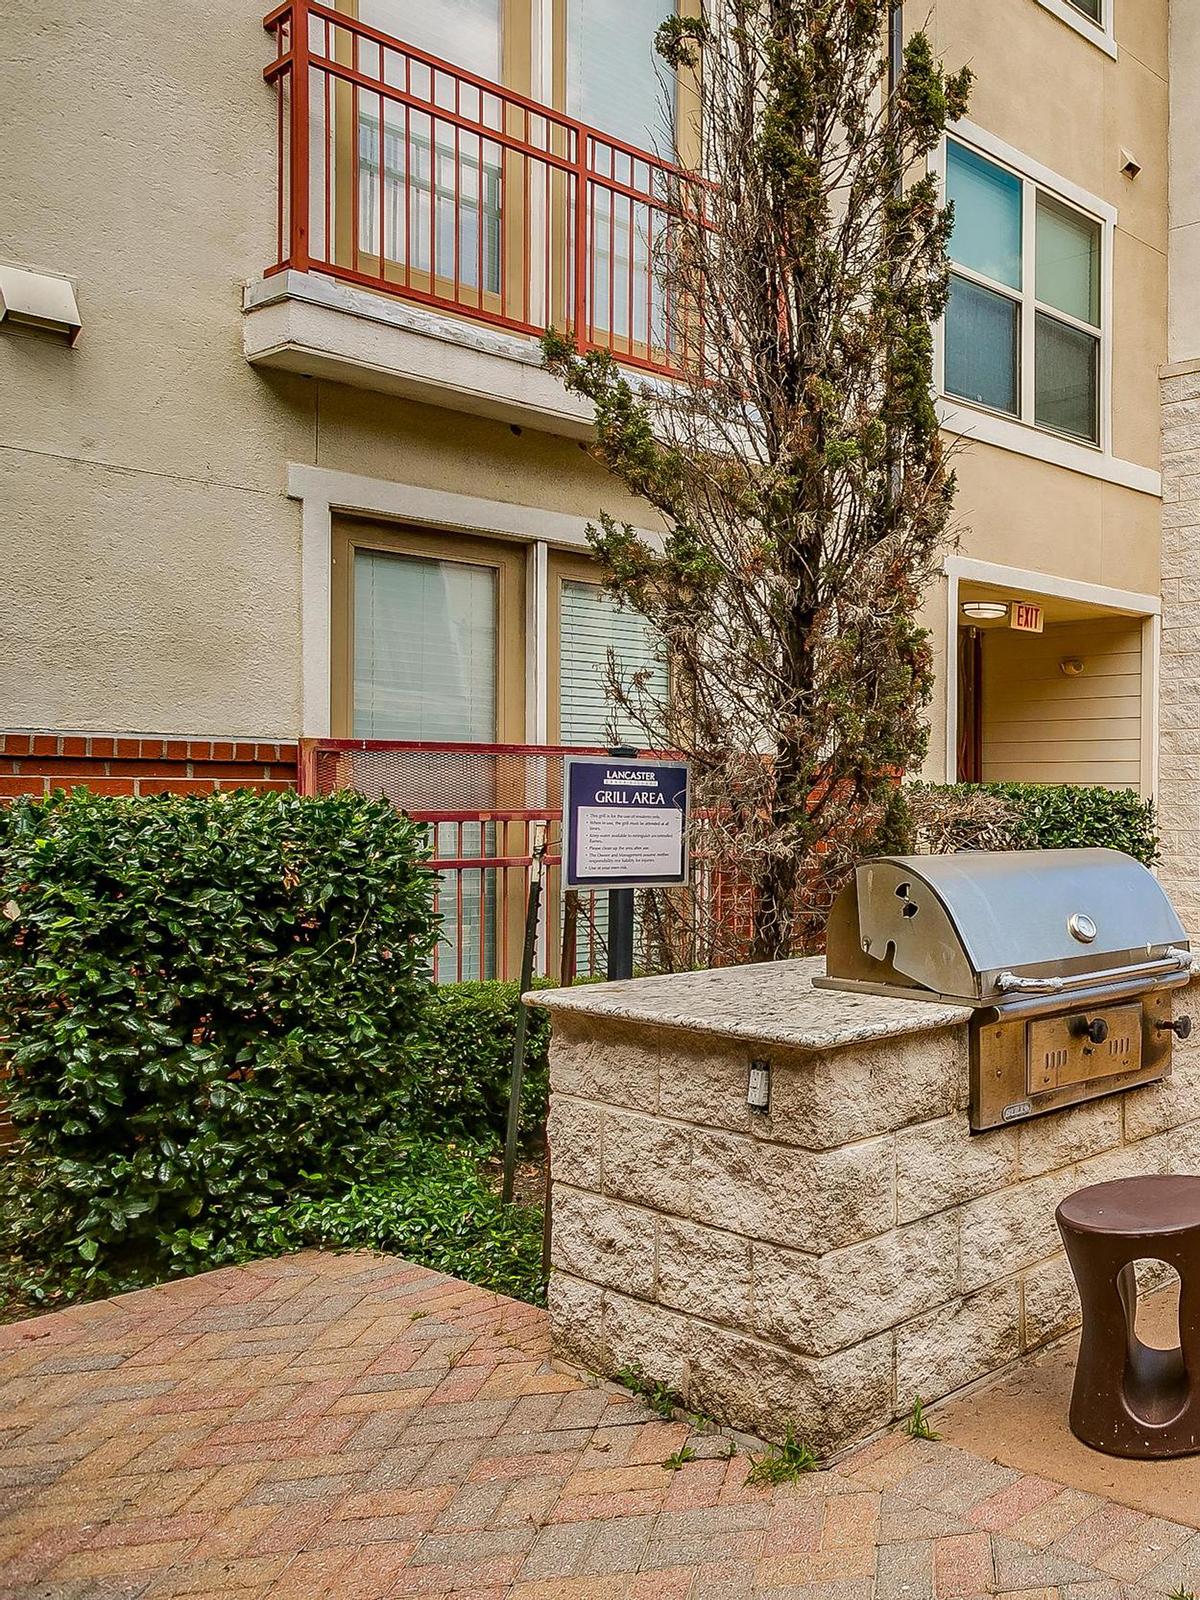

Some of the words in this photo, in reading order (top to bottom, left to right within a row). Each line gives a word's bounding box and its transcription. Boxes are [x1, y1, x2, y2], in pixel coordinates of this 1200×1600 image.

[1018, 606, 1040, 629] EXIT
[606, 770, 655, 780] LANCASTER
[595, 790, 629, 804] GRILL
[632, 792, 665, 804] AREA
